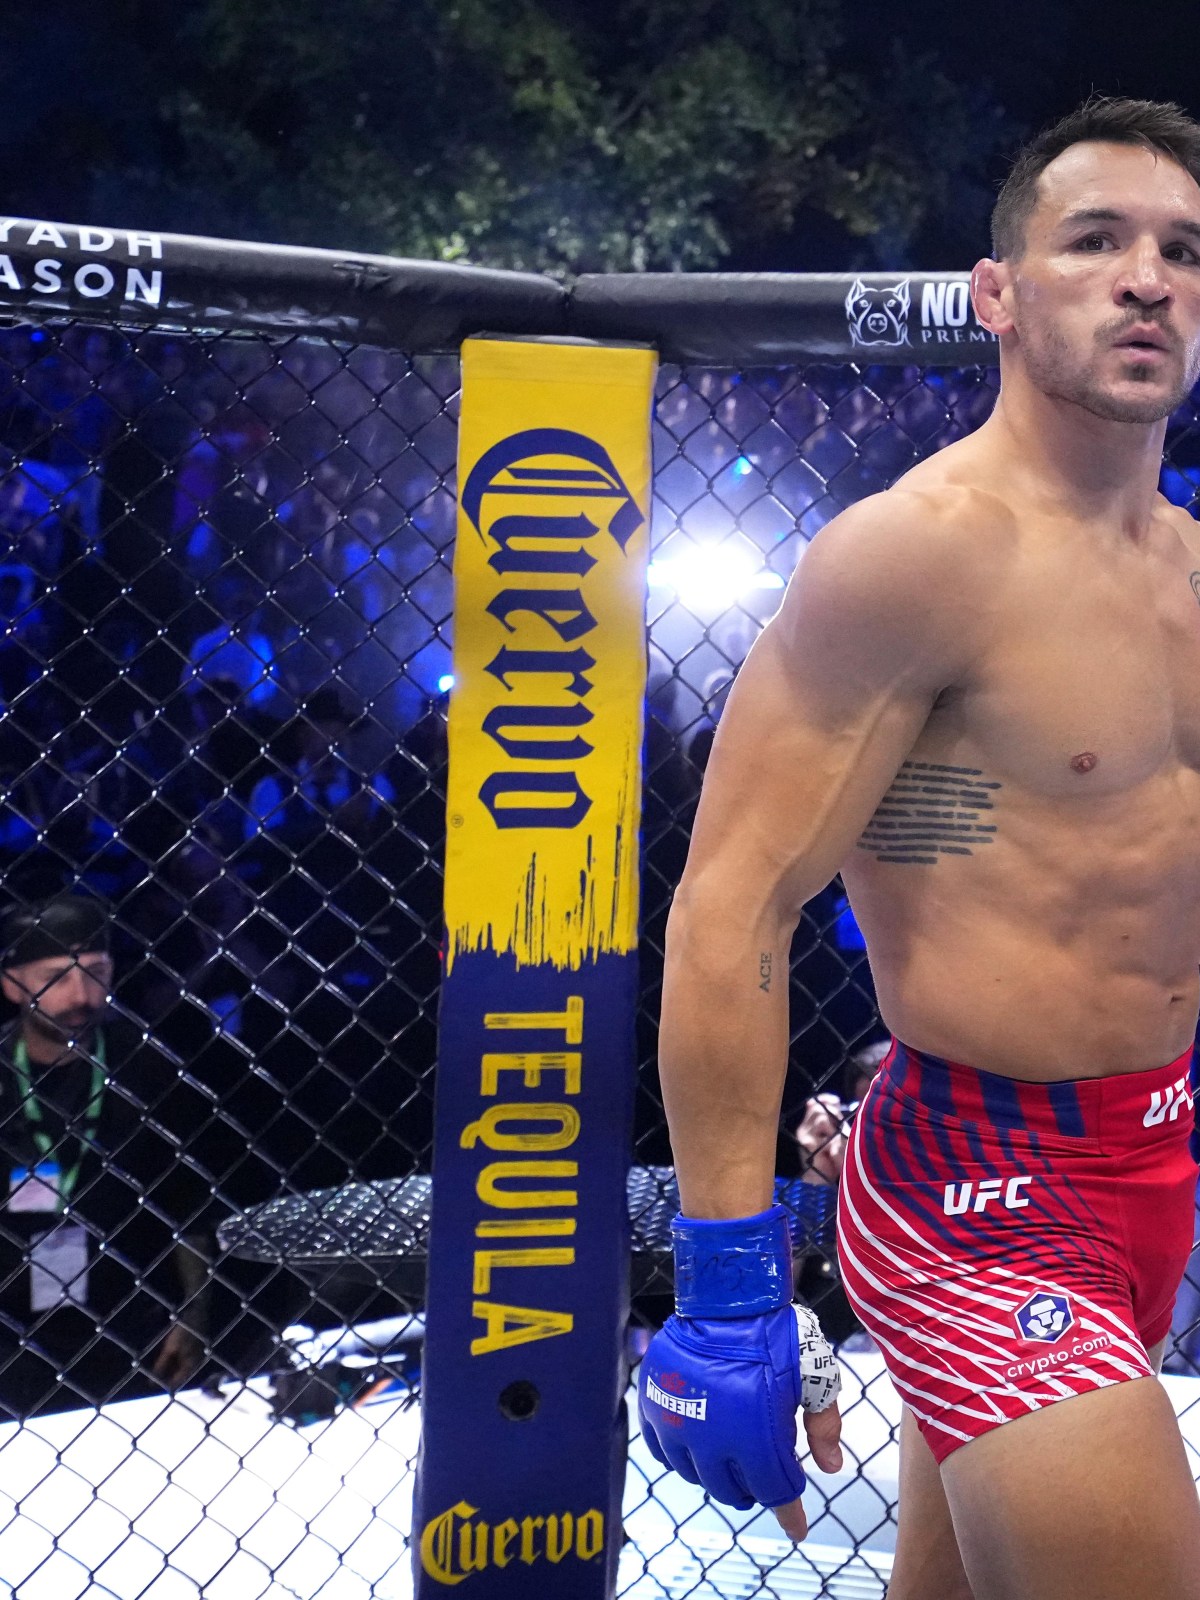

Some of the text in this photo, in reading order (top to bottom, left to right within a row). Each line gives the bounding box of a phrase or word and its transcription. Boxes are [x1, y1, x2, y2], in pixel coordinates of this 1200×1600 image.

[461, 427, 645, 830] Cuervo
[759, 952, 772, 993] ACE
[460, 996, 584, 1356] TEQUILA
[944, 1176, 1032, 1215] UFC
[814, 1355, 835, 1369] UFC
[1007, 1336, 1108, 1377] crypto.com
[647, 1375, 707, 1421] FREEDOM
[420, 1500, 604, 1585] Cuervo
